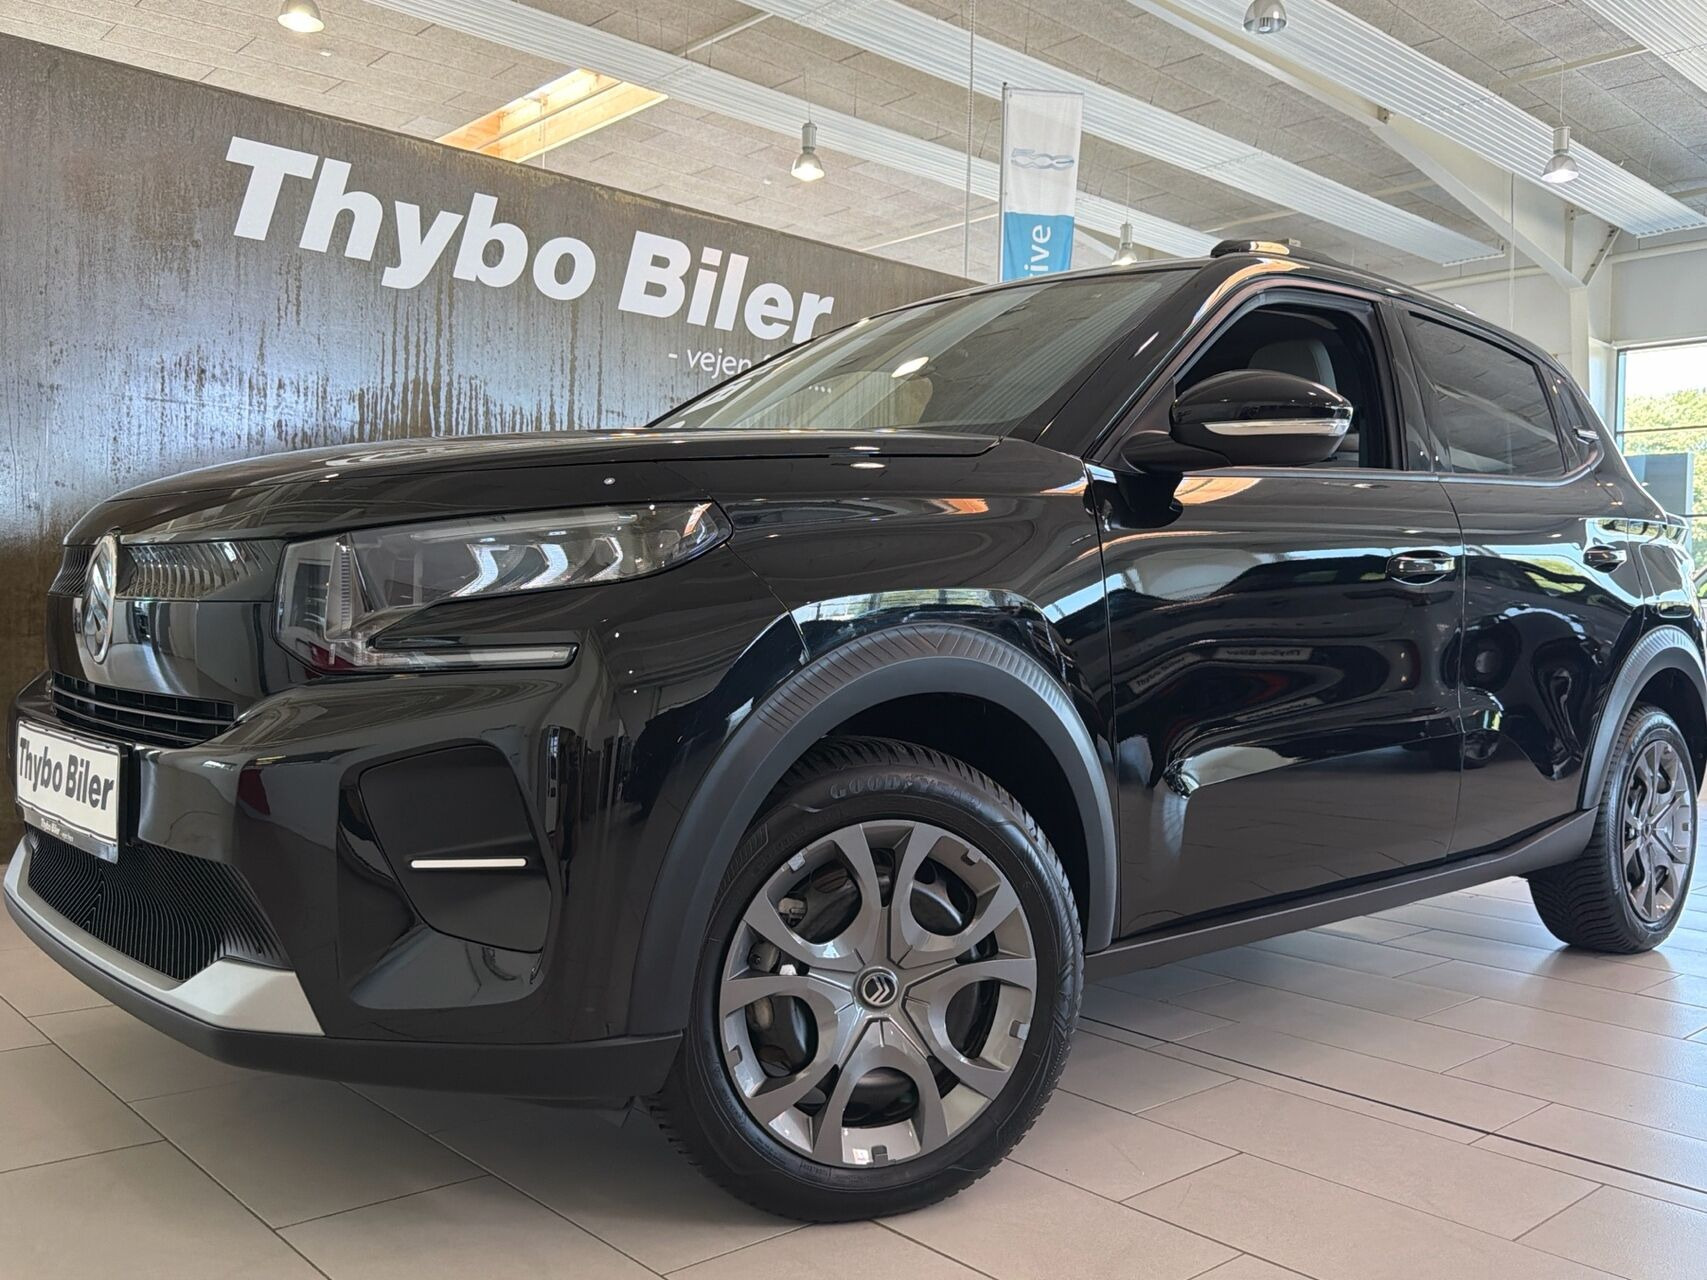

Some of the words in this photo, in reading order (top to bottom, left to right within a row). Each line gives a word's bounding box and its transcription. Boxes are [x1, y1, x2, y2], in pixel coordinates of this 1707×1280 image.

[225, 136, 596, 300] Thybo
[618, 230, 834, 343] Biler
[687, 348, 752, 379] vejen
[19, 737, 63, 792] Thybo
[65, 754, 114, 811] Biler
